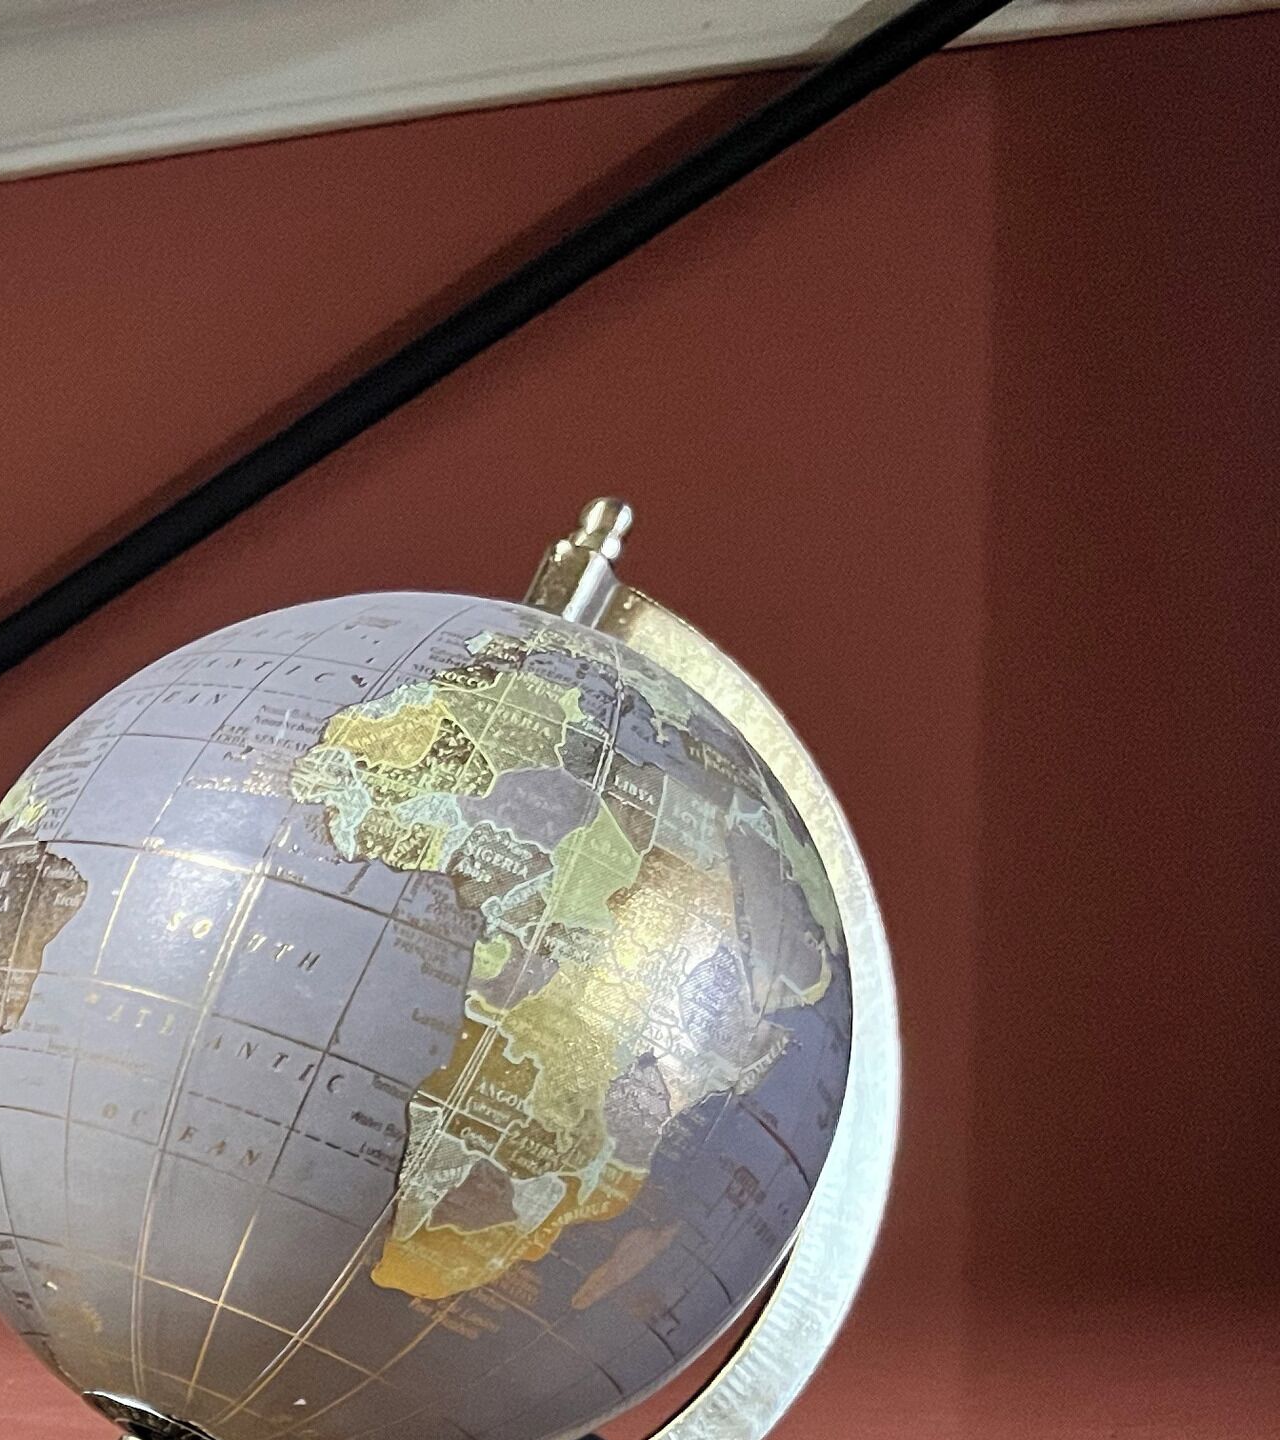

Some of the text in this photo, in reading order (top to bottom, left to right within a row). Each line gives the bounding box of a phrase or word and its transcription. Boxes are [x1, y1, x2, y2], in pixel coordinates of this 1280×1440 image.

[412, 663, 490, 688] MOROCCO
[614, 774, 654, 806] LIBYA
[166, 911, 321, 971] SOUTH
[107, 1003, 344, 1093] ATLANTIC
[478, 1076, 526, 1112] ANGOL
[102, 1103, 262, 1167] OCEAN
